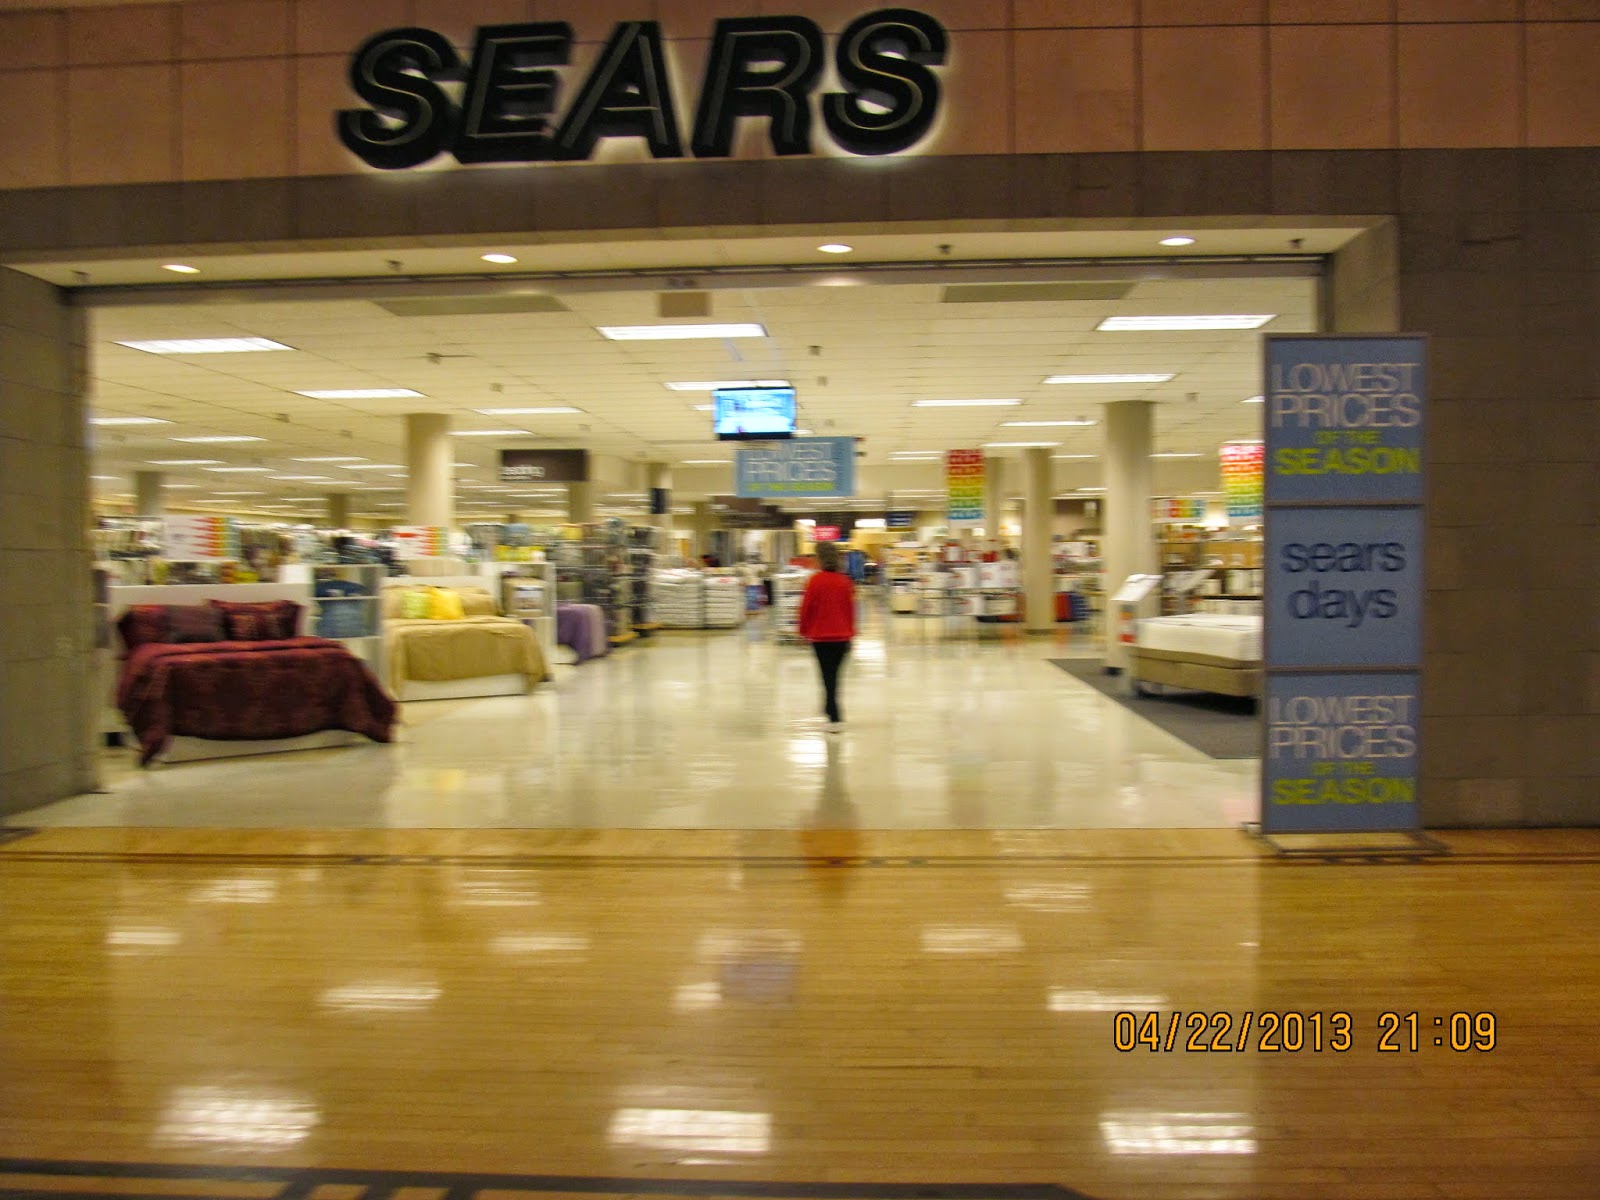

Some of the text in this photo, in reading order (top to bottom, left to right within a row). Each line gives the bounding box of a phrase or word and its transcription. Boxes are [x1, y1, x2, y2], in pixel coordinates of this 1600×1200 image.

[336, 8, 948, 170] SEARS
[1271, 362, 1422, 393] LOWEST
[1271, 393, 1422, 428] PRICES
[1274, 447, 1421, 475] SEASON
[1280, 542, 1406, 573] sears
[1287, 579, 1399, 628] days
[1268, 695, 1415, 725] LOWEST
[1268, 724, 1417, 760] PRICES
[1270, 777, 1416, 805] SEASON
